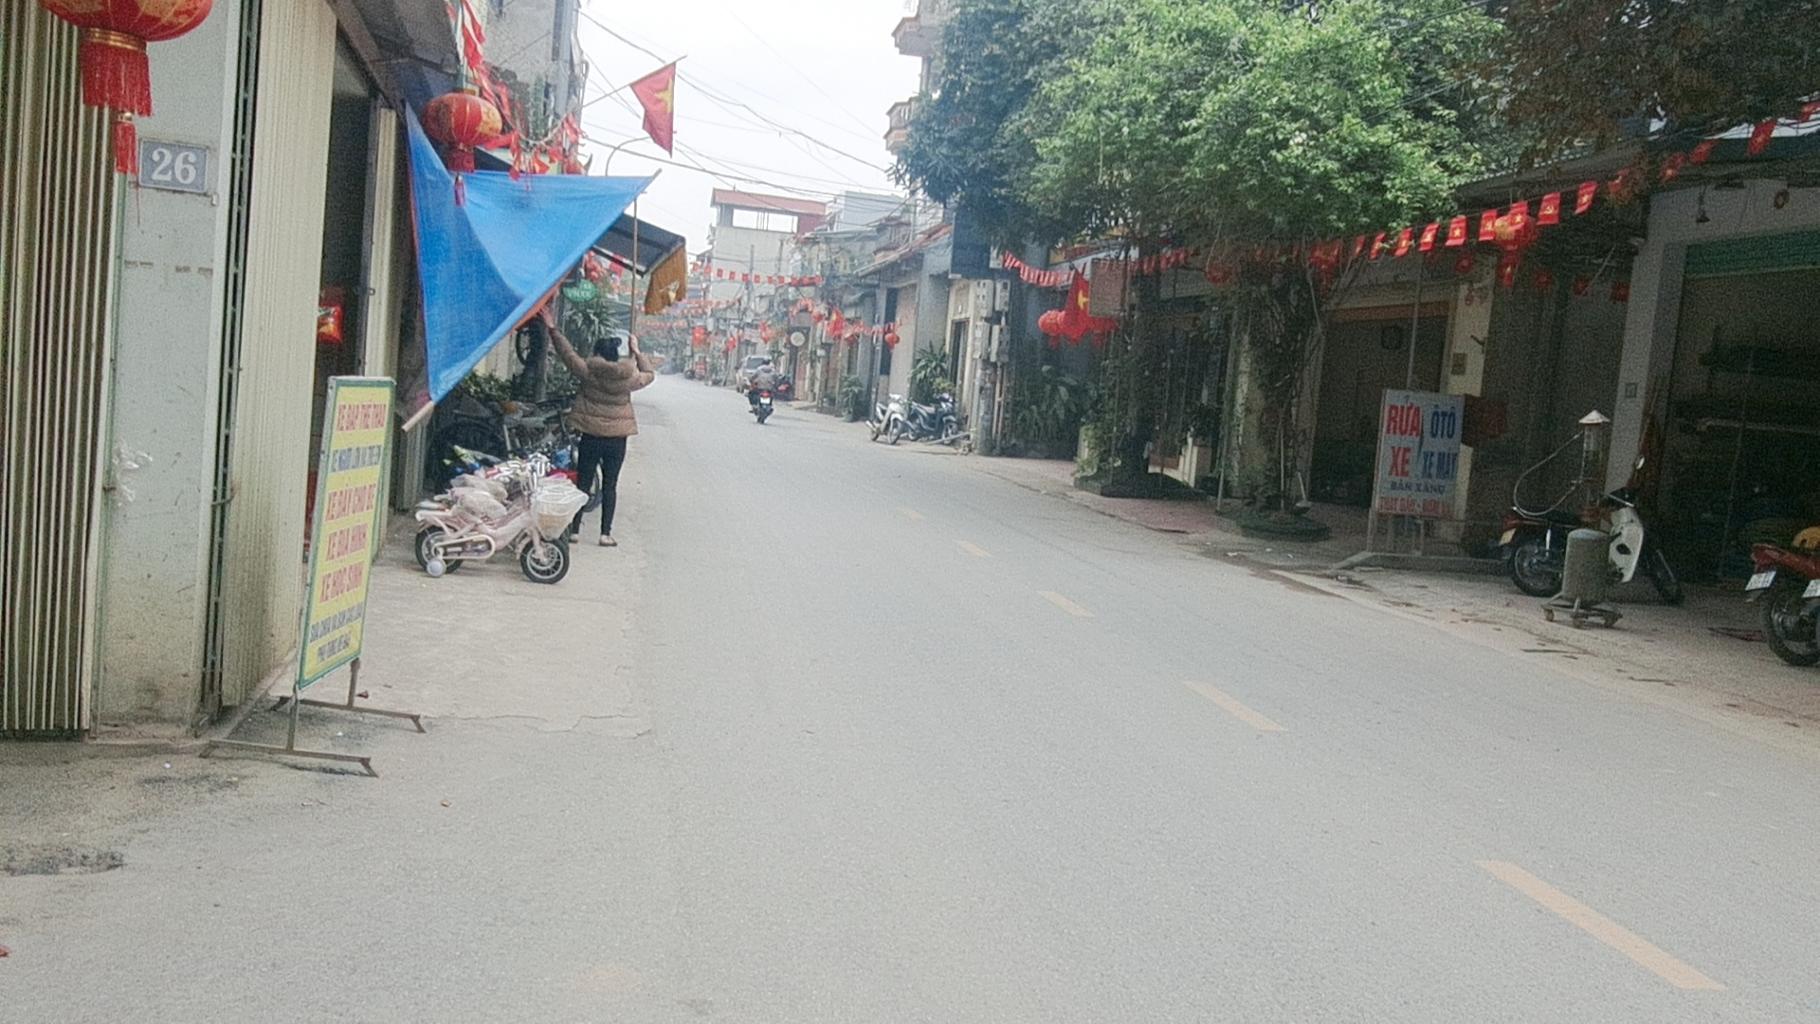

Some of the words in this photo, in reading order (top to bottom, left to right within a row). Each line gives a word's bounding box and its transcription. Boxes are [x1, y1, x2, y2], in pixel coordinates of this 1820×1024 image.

[151, 147, 197, 185] 26
[336, 403, 346, 432] XE
[1385, 396, 1421, 437] RỬA
[1388, 446, 1411, 478] XE
[1421, 451, 1434, 479] XE
[325, 492, 337, 522] XE
[326, 531, 337, 560] XE
[320, 573, 331, 603] XE
